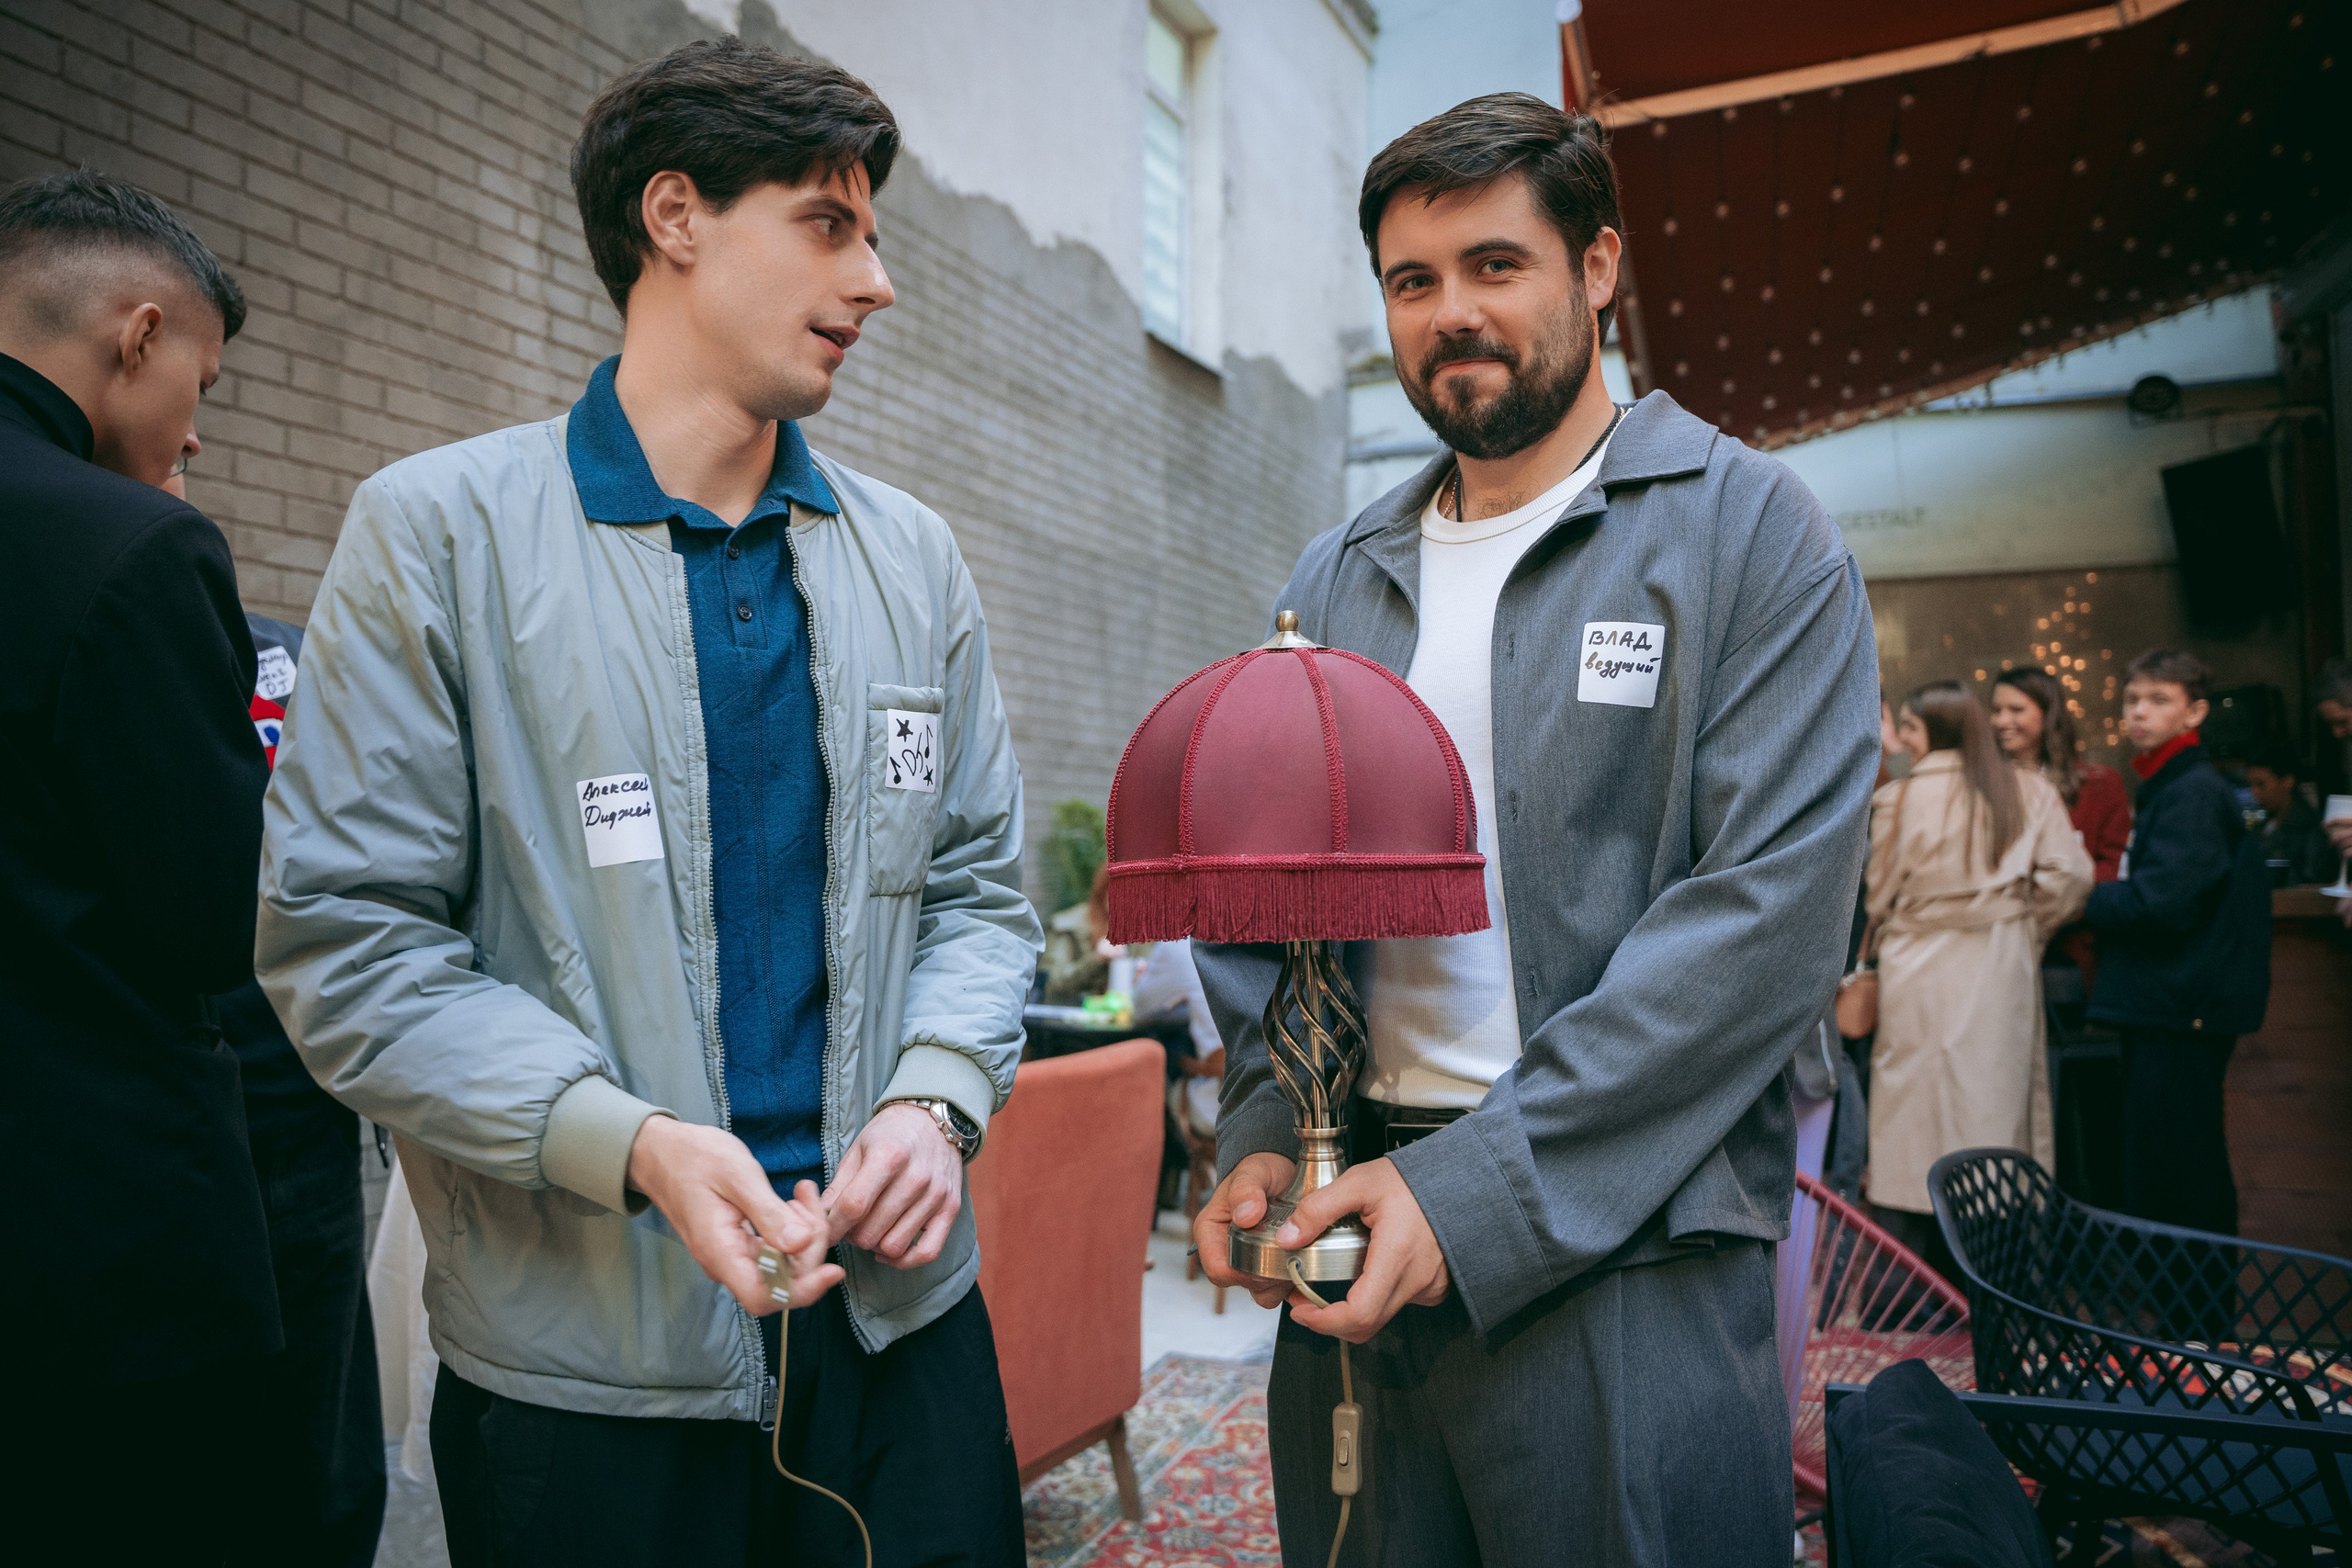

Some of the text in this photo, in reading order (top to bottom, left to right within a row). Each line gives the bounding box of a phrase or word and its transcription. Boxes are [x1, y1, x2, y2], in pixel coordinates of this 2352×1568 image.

[1588, 630, 1653, 652] ВЛАД
[1585, 651, 1661, 679] ведущий
[582, 777, 649, 802] Алексей
[584, 801, 651, 829] Диджей
